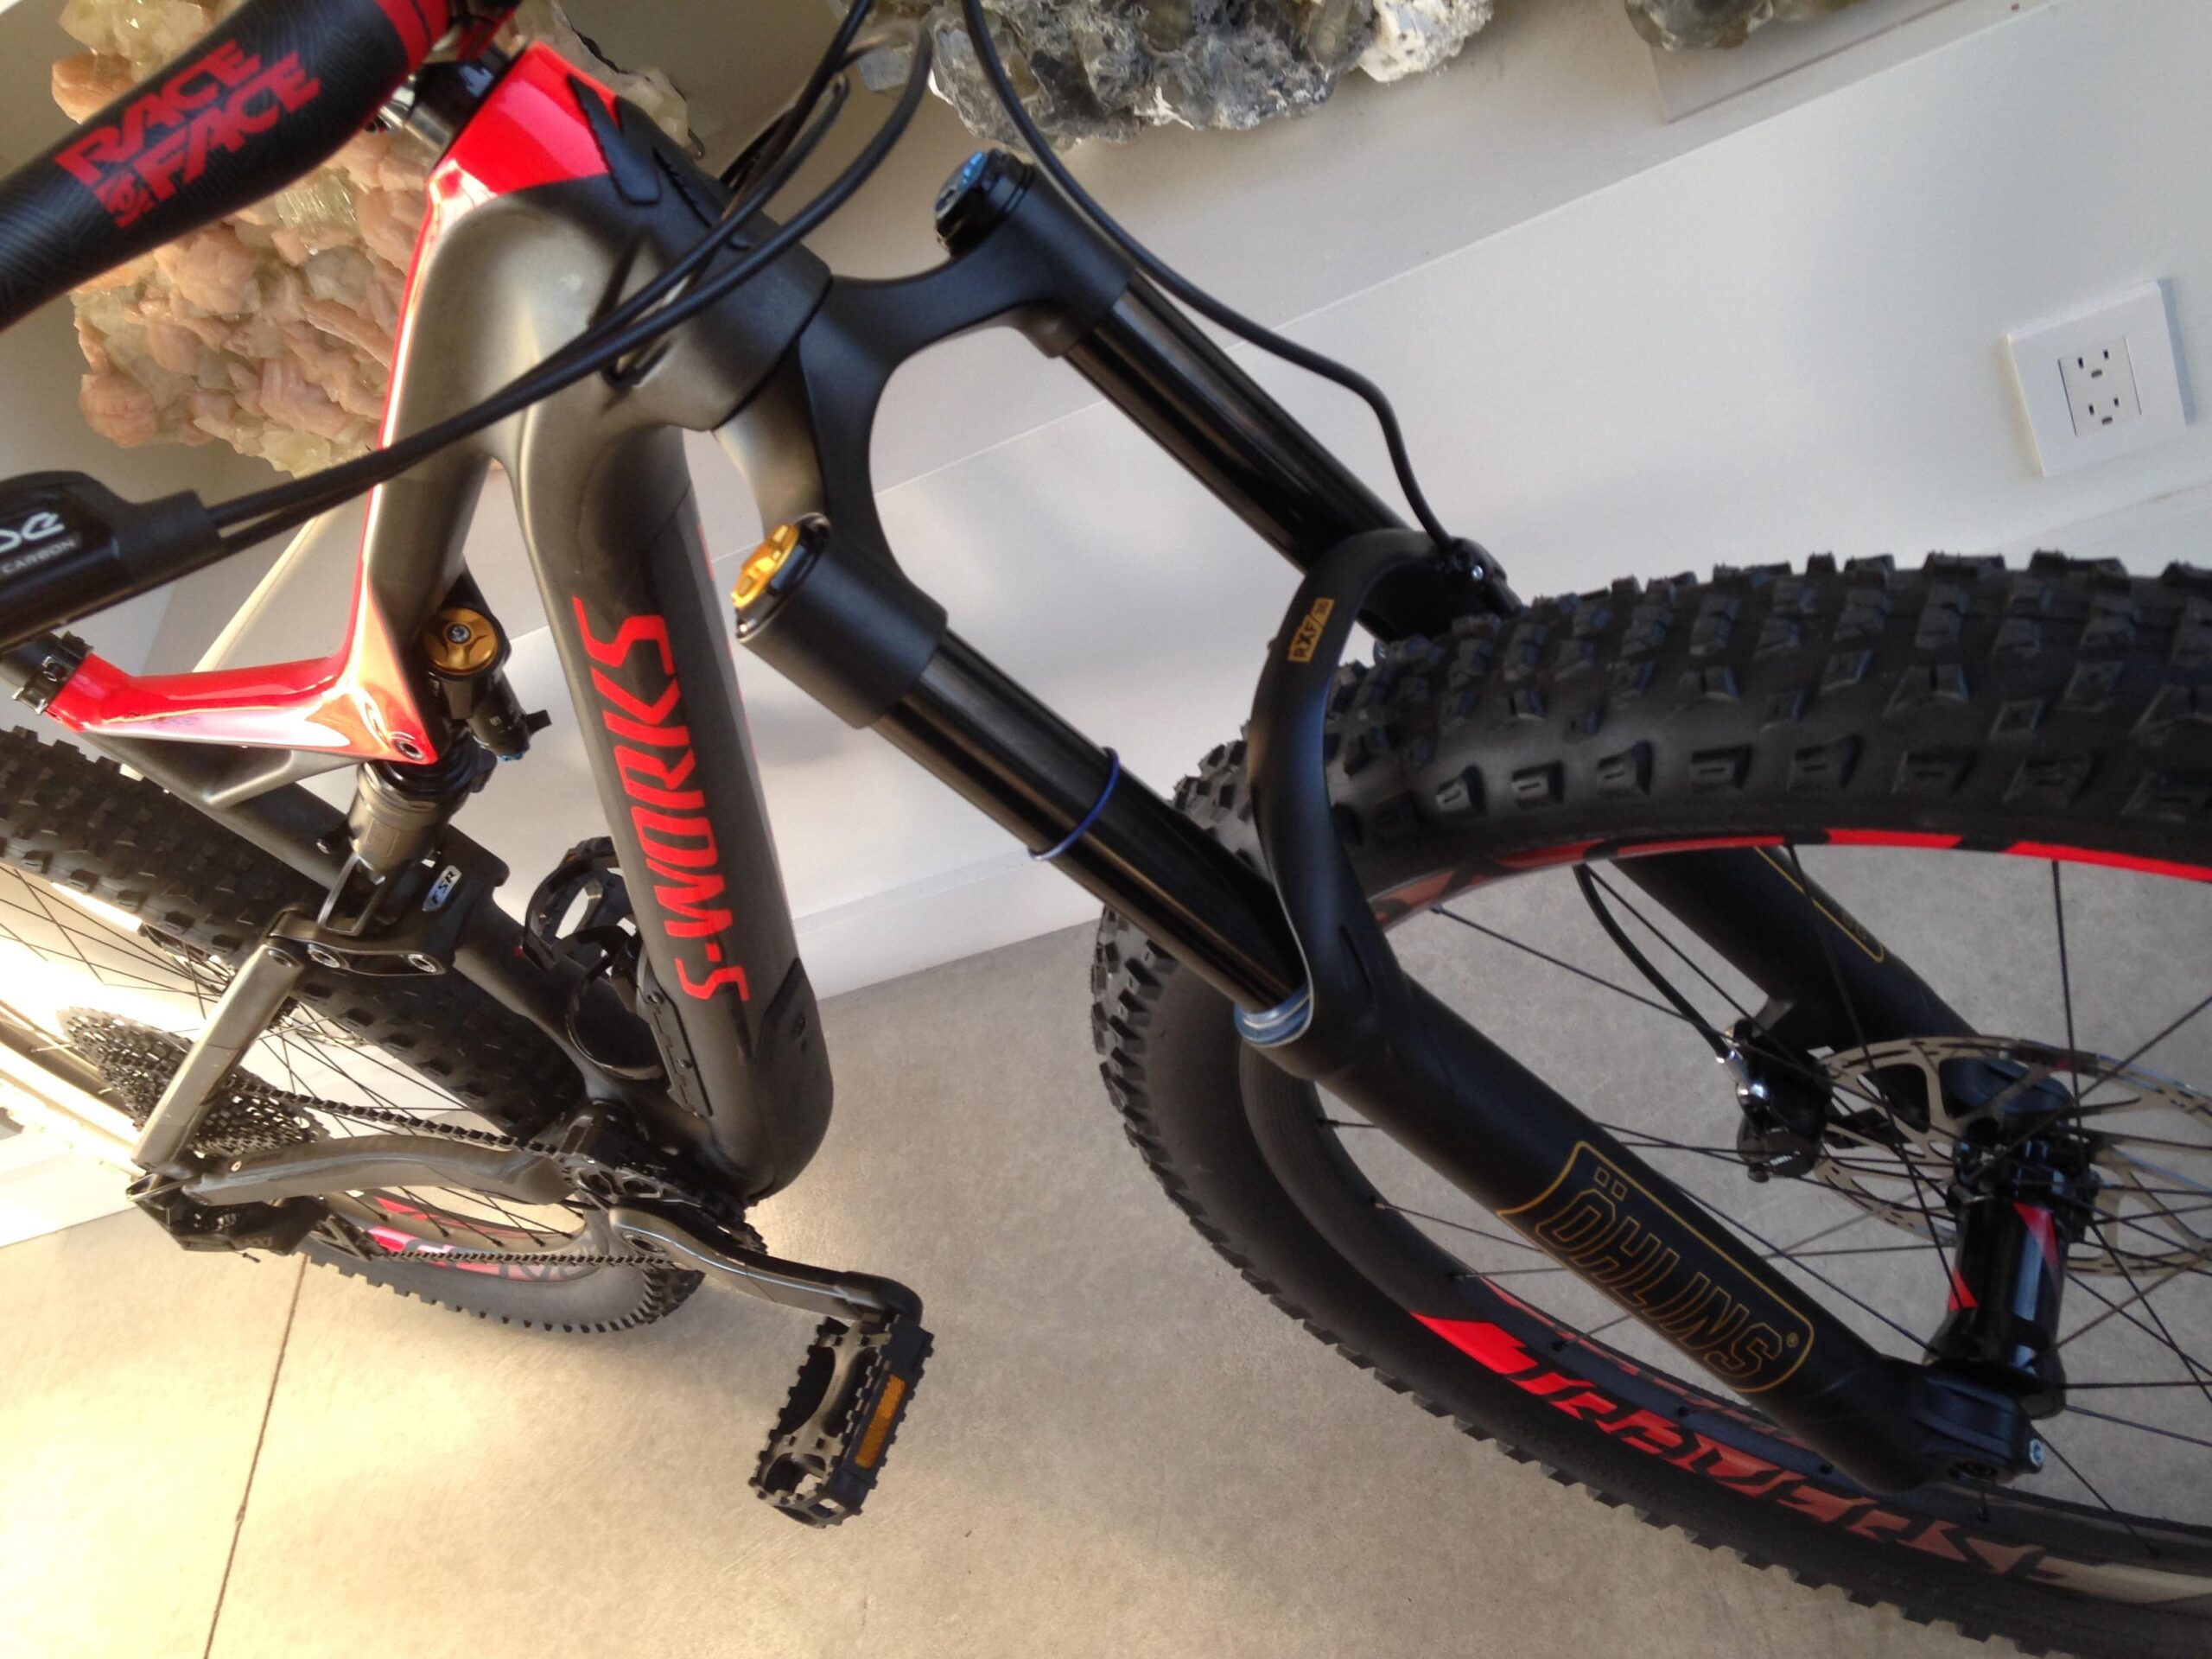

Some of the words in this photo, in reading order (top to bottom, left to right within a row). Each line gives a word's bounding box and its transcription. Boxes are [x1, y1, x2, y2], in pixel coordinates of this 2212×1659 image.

[54, 39, 262, 186] RACE
[133, 51, 321, 201] FACE
[572, 595, 750, 1002] S-WORKS
[431, 870, 456, 905] FSR
[1535, 1165, 1783, 1379] ÖHLINS
